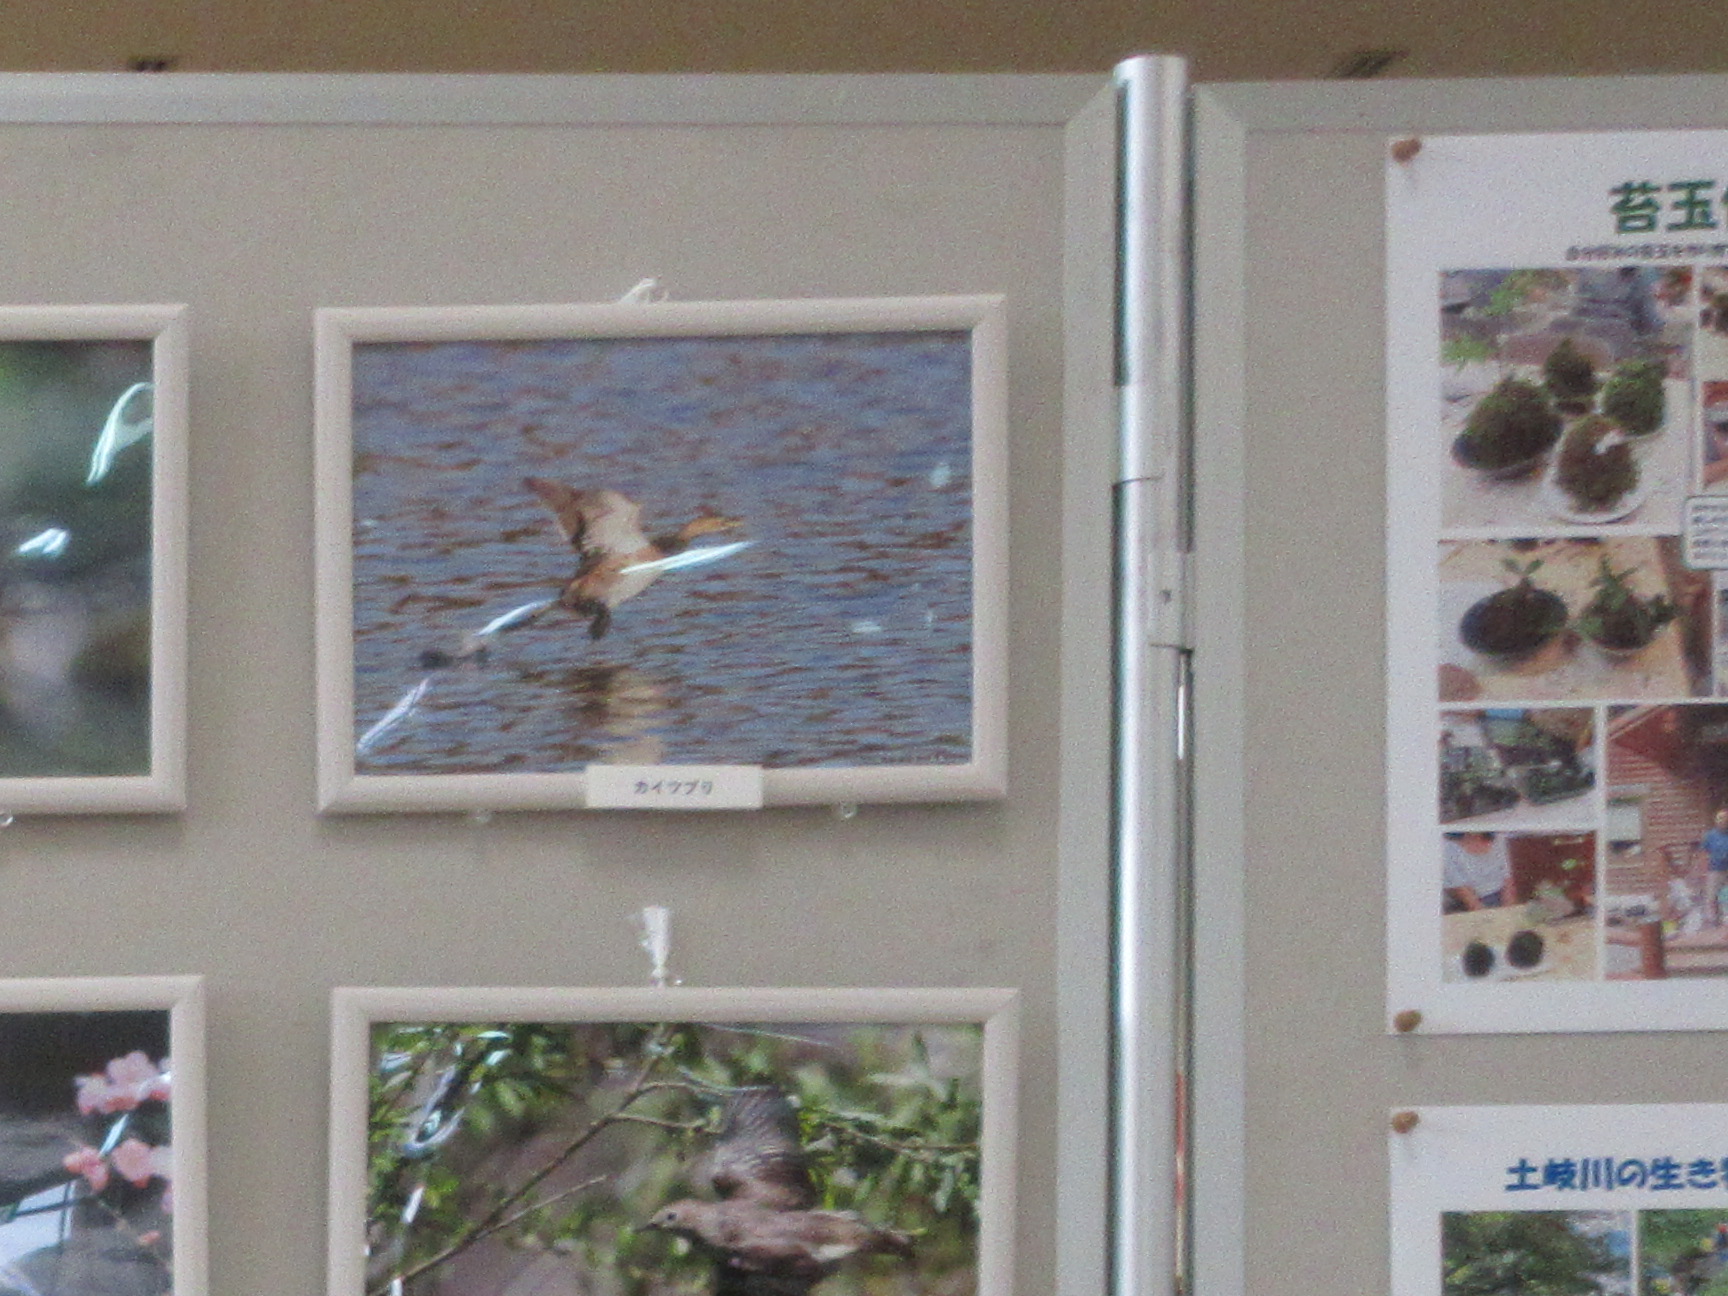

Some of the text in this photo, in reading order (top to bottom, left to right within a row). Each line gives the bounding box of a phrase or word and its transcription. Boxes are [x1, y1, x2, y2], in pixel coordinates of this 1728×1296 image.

[1608, 179, 1728, 234] 苔玉
[1504, 1156, 1728, 1192] 土岐川の生き
